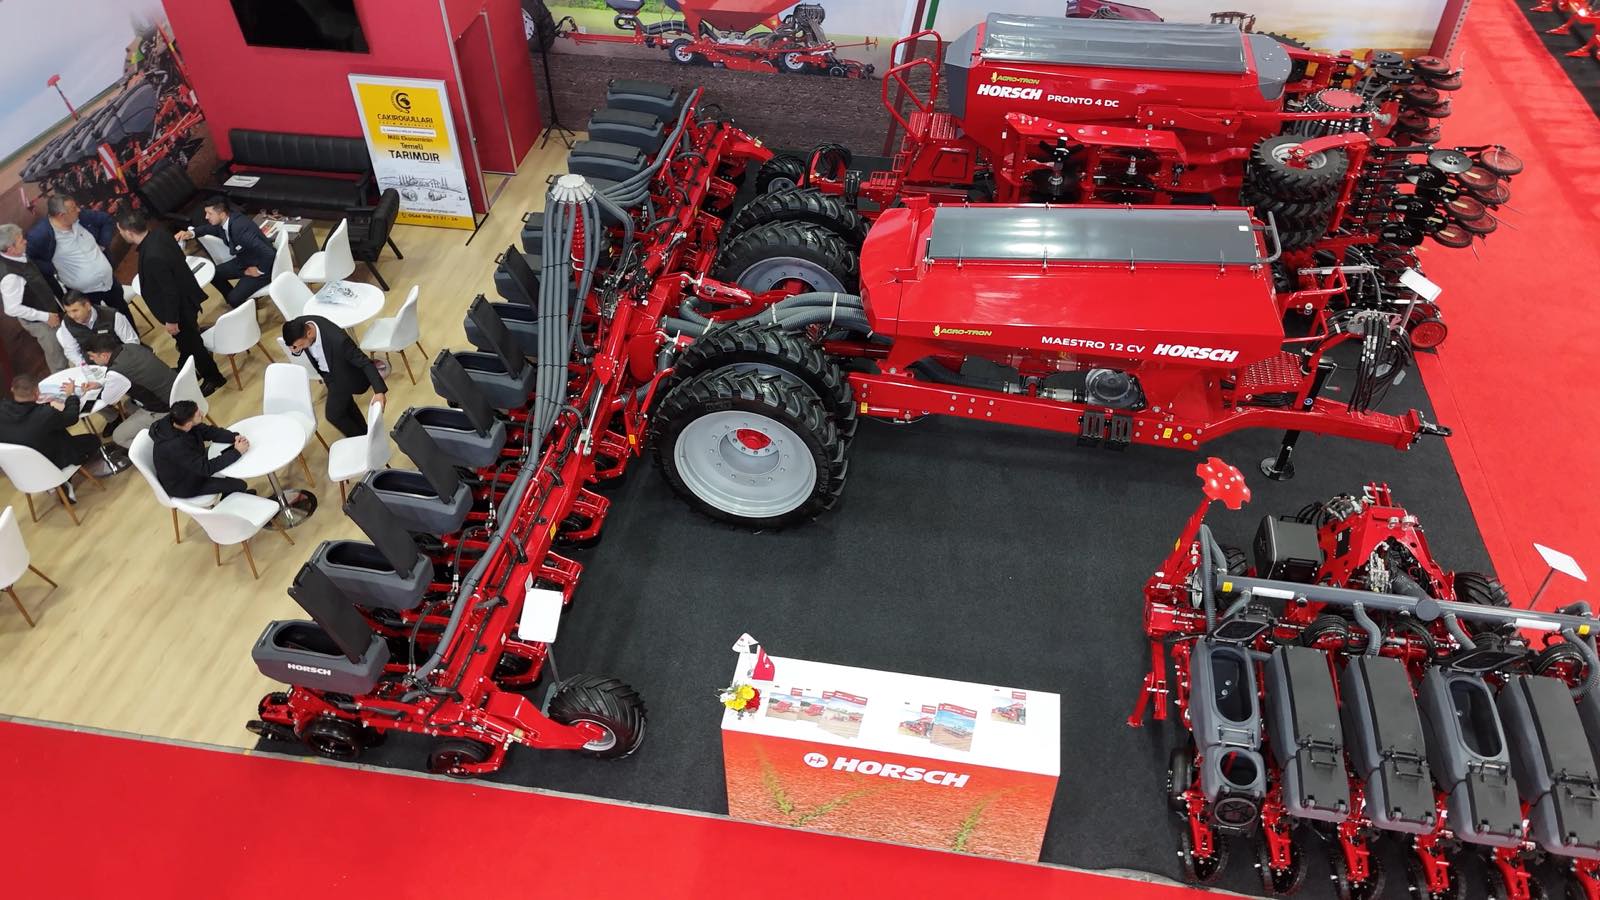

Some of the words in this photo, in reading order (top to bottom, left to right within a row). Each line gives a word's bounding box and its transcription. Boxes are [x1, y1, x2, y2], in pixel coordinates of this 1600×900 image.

[997, 75, 1040, 84] AGRO-TRON
[977, 83, 1043, 100] HORSCH
[1047, 94, 1093, 106] PRONTO
[1095, 98, 1102, 106] 4
[1104, 99, 1120, 108] DC
[388, 150, 440, 162] TARIMDIR
[940, 328, 993, 336] AGRO-TRON
[1041, 336, 1105, 349] MAESTRO
[1109, 342, 1124, 351] 12
[1126, 344, 1146, 353] CV
[1153, 343, 1239, 363] HORSCH
[287, 663, 331, 676] HORSCH
[832, 756, 970, 788] HORSCH
